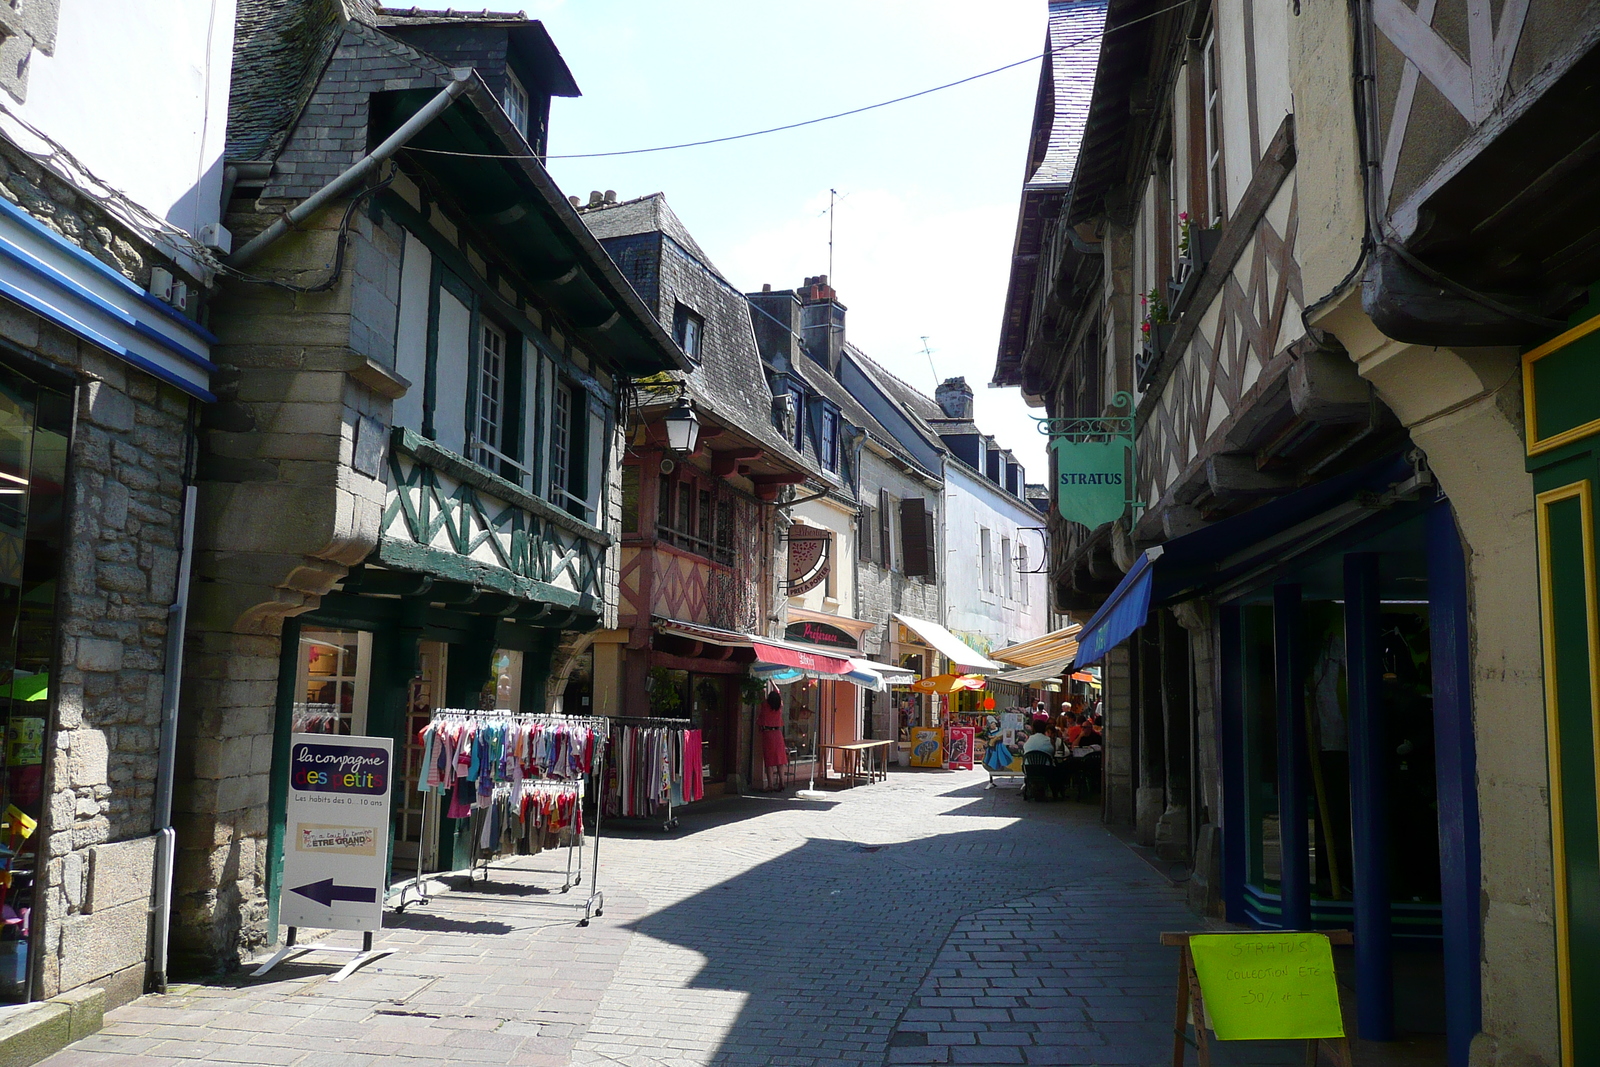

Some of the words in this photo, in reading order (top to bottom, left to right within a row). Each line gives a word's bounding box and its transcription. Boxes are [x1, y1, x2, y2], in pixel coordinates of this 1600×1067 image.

[1061, 473, 1122, 485] STRATUS
[810, 566, 830, 587] PORTER
[296, 746, 314, 763] la
[315, 753, 385, 774] compagnie
[295, 767, 328, 785] des
[332, 771, 384, 790] petits
[295, 794, 306, 802] Les
[309, 795, 331, 804] habits
[333, 796, 345, 805] des
[1231, 941, 1308, 957] STRATUS
[1226, 965, 1289, 980] COLLECTION
[1281, 992, 1292, 1002] et
